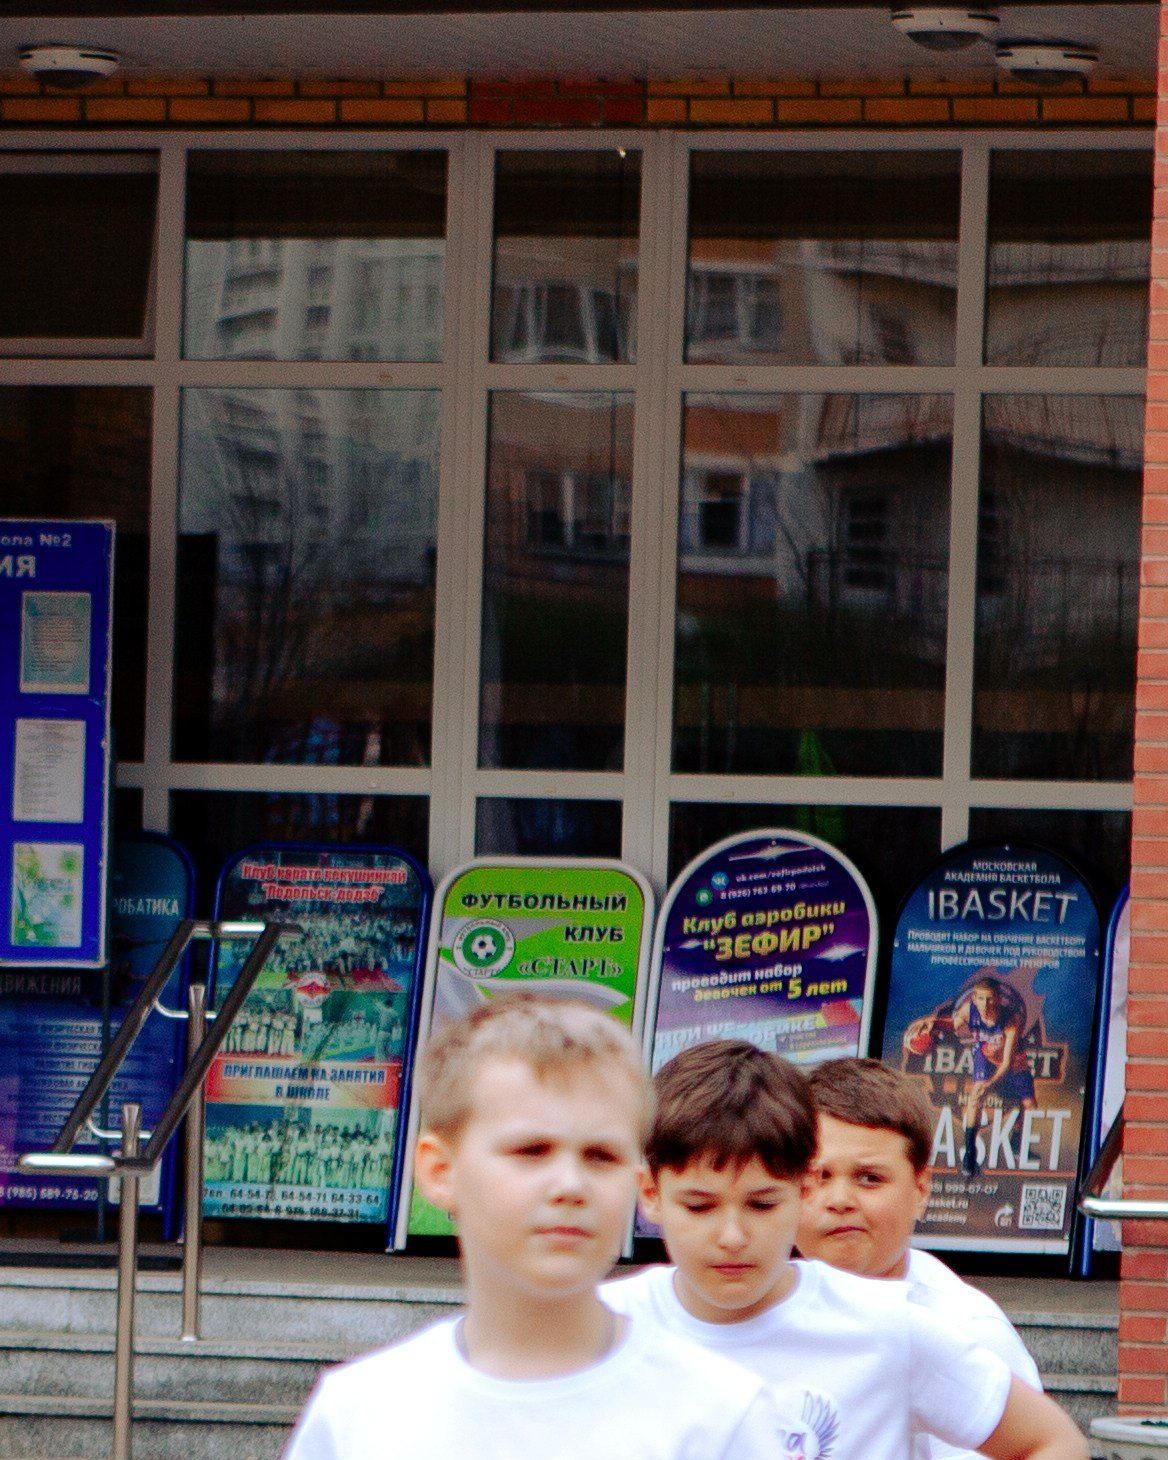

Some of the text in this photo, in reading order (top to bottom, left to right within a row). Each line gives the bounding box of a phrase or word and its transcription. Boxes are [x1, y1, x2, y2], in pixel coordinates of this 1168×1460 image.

[40, 532, 72, 547] №2
[242, 862, 274, 880] Клуб
[276, 865, 322, 881] карате
[972, 860, 1037, 872] МОСКОВСКАЯ
[944, 870, 1061, 885] АКАДЕМИЯ БАСКЕТБОЛА
[461, 892, 628, 912] ФУТБОЛЬНЫЙ
[928, 887, 1078, 924] IBASKET
[683, 901, 846, 936] Клуб аэробики
[564, 926, 624, 942] КЛУБ
[703, 922, 835, 960] "ЗЕФИР"
[518, 957, 623, 977] «СТАРТ»
[672, 963, 803, 992] проводит набор
[694, 978, 848, 1002] девочек от 5 лет
[223, 1063, 387, 1083] ПРИГЛАШАЕМ НА ЗАНЯТИЯ
[275, 1085, 331, 1101] В ШКОЛЕ
[928, 1106, 1072, 1172] ASKET
[928, 1197, 969, 1210] asket.ru
